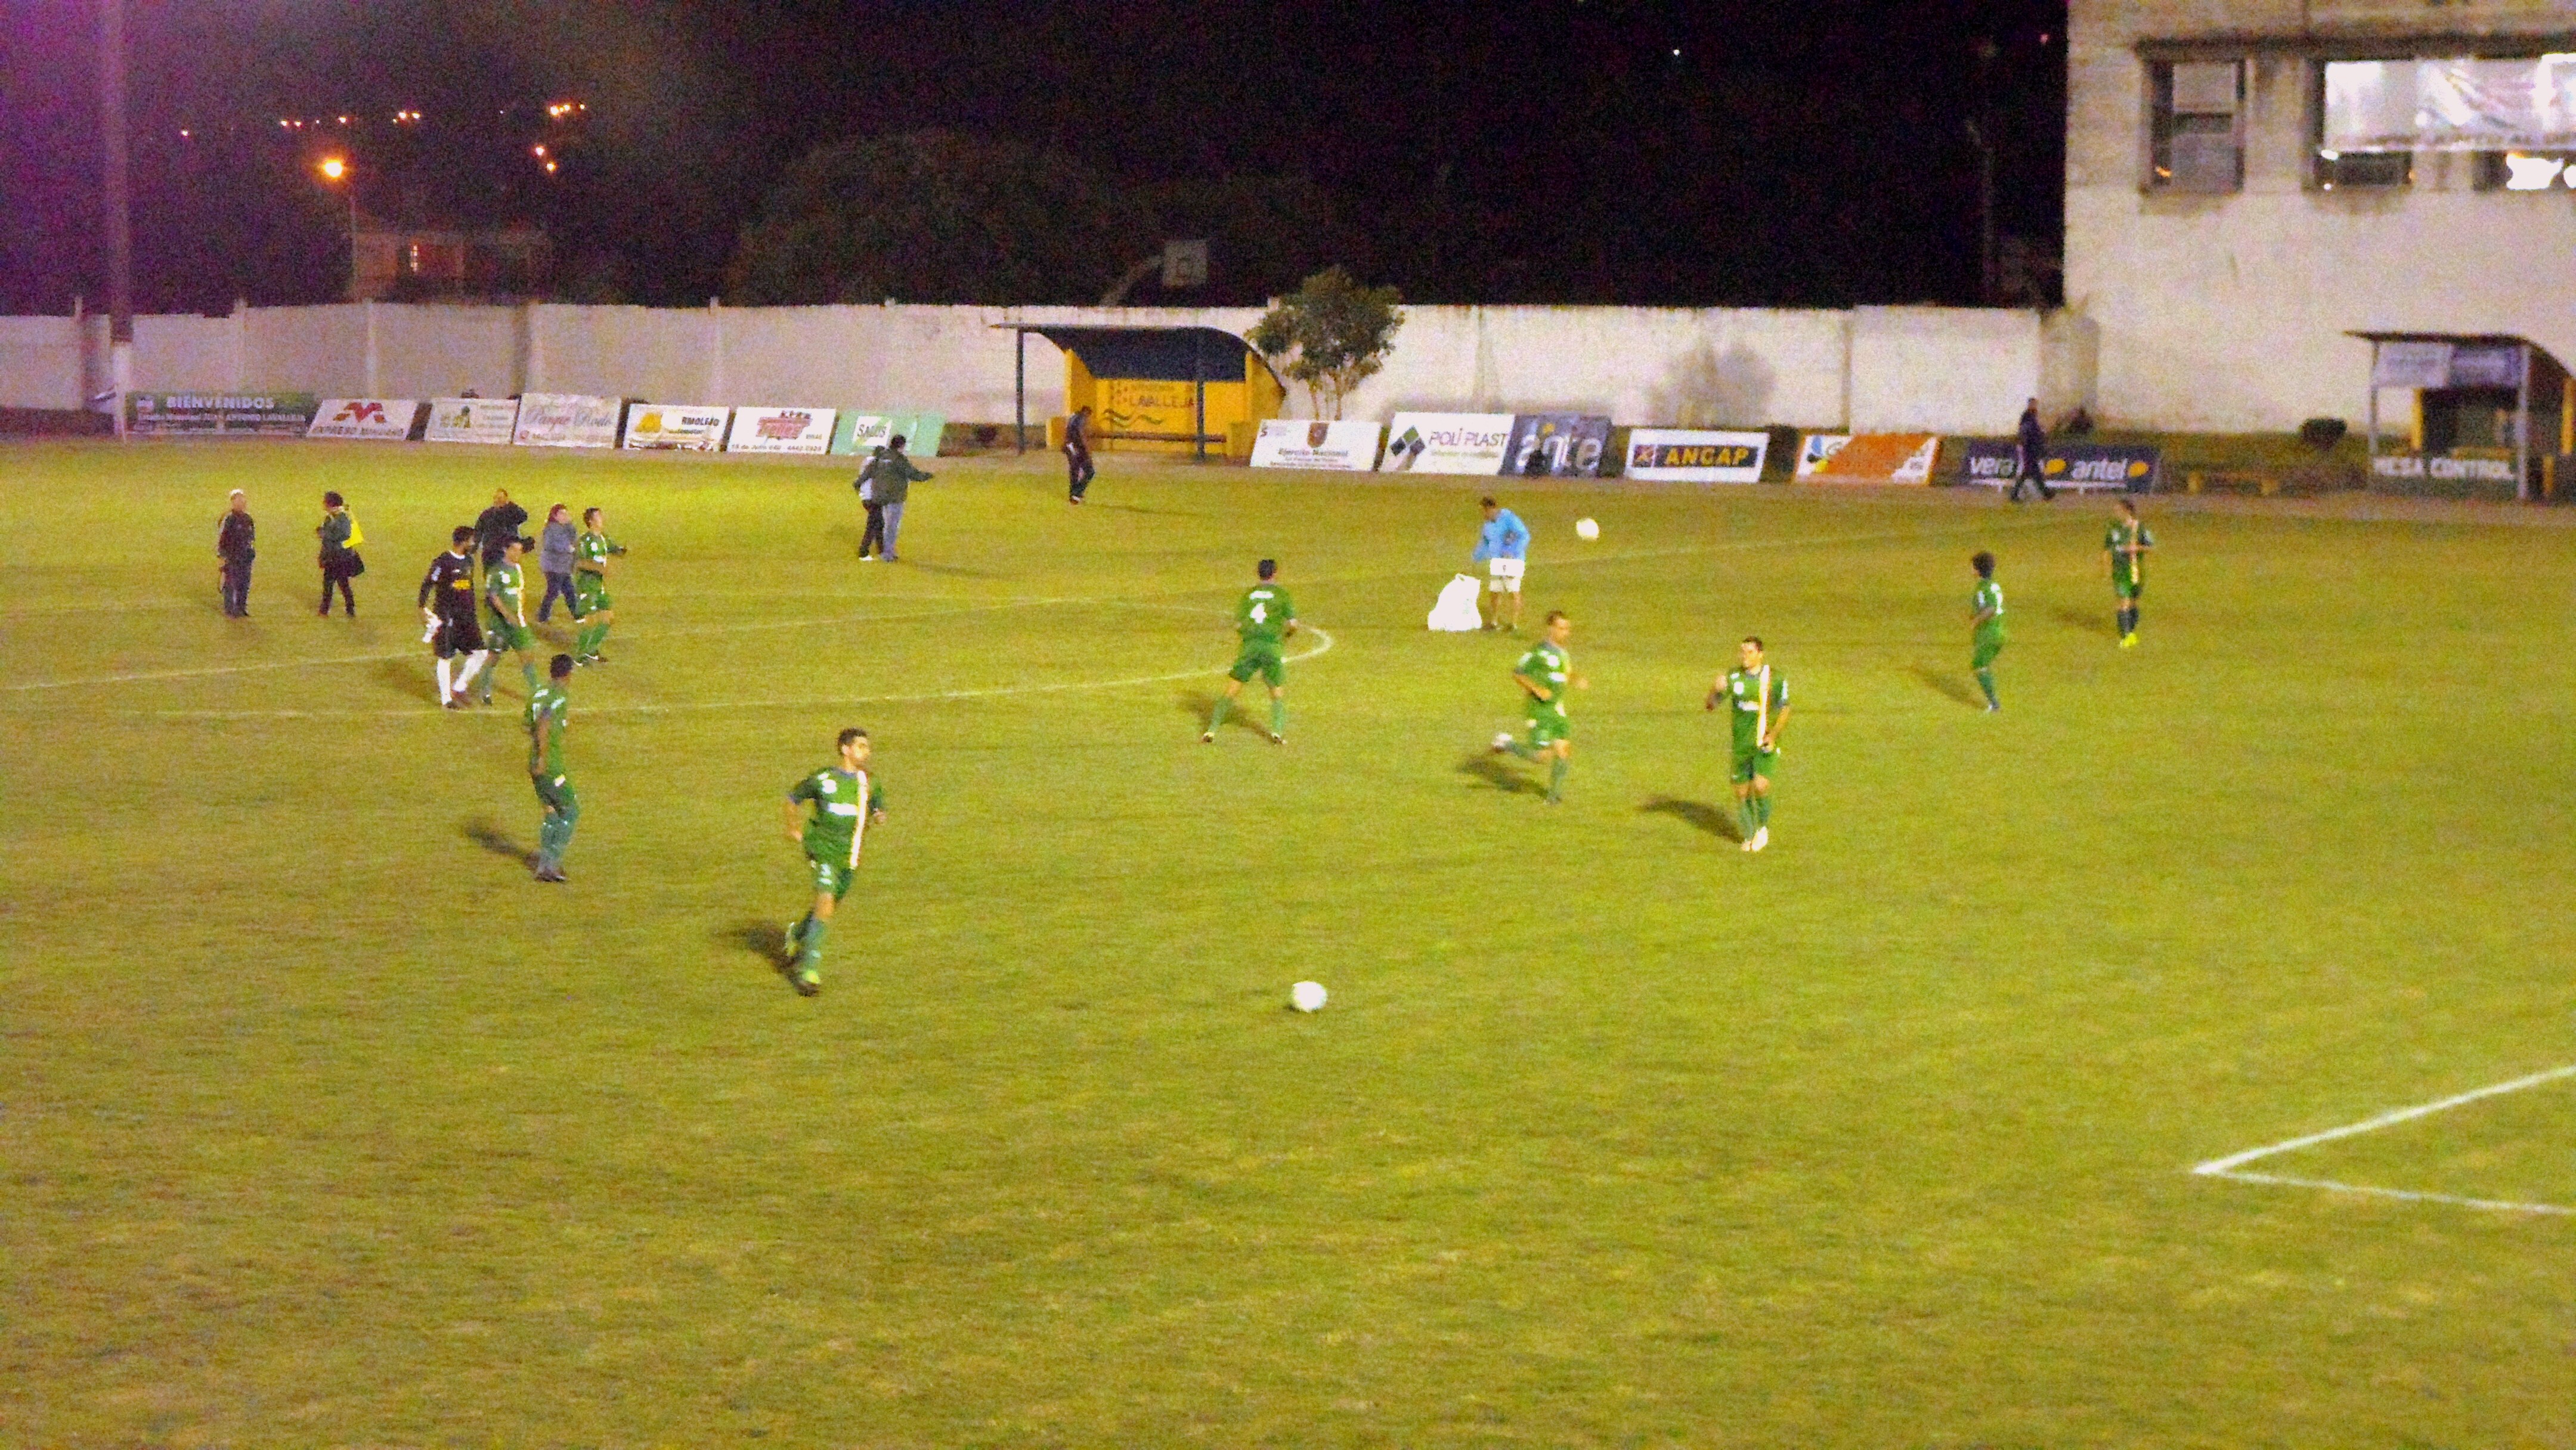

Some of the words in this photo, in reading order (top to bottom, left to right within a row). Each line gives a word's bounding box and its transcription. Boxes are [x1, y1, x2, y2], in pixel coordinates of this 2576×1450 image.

[166, 396, 274, 408] BIENVENIDOS
[1665, 446, 1749, 466] ANCAP
[2072, 458, 2127, 479] antel
[1250, 602, 1267, 624] 4
